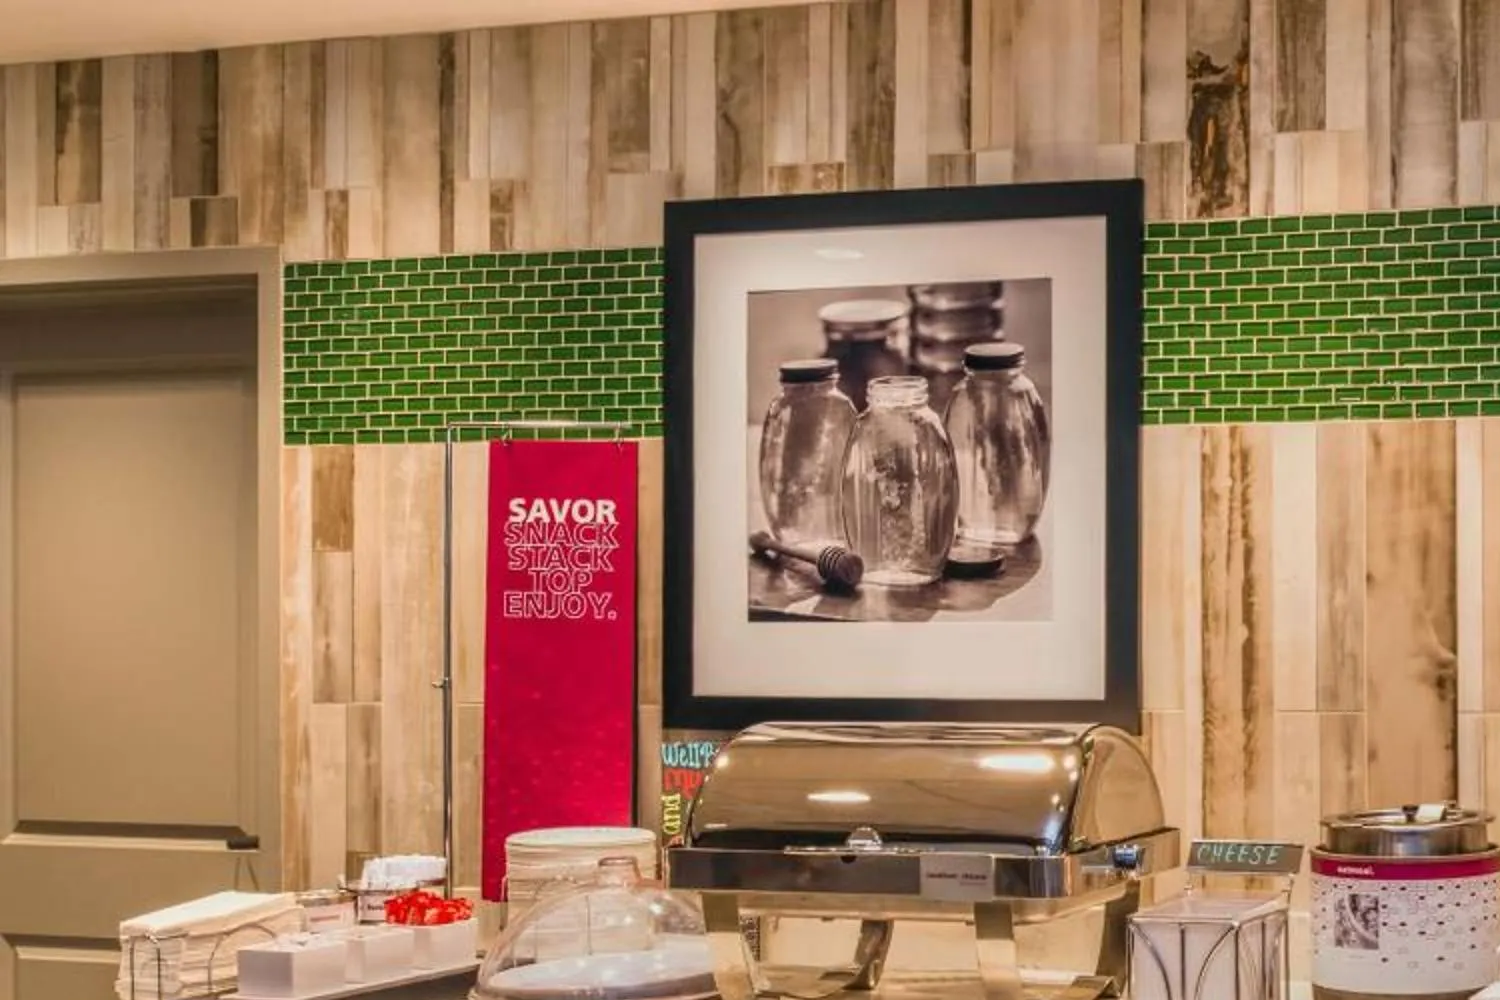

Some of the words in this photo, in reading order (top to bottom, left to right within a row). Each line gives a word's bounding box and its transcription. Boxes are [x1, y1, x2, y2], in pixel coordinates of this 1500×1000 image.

[508, 497, 618, 524] SAVOR
[504, 521, 619, 548] SNACK
[508, 545, 614, 572] STACK
[528, 568, 593, 595] TOP
[503, 591, 618, 621] ENJOY.
[1196, 843, 1284, 865] CHEESE
